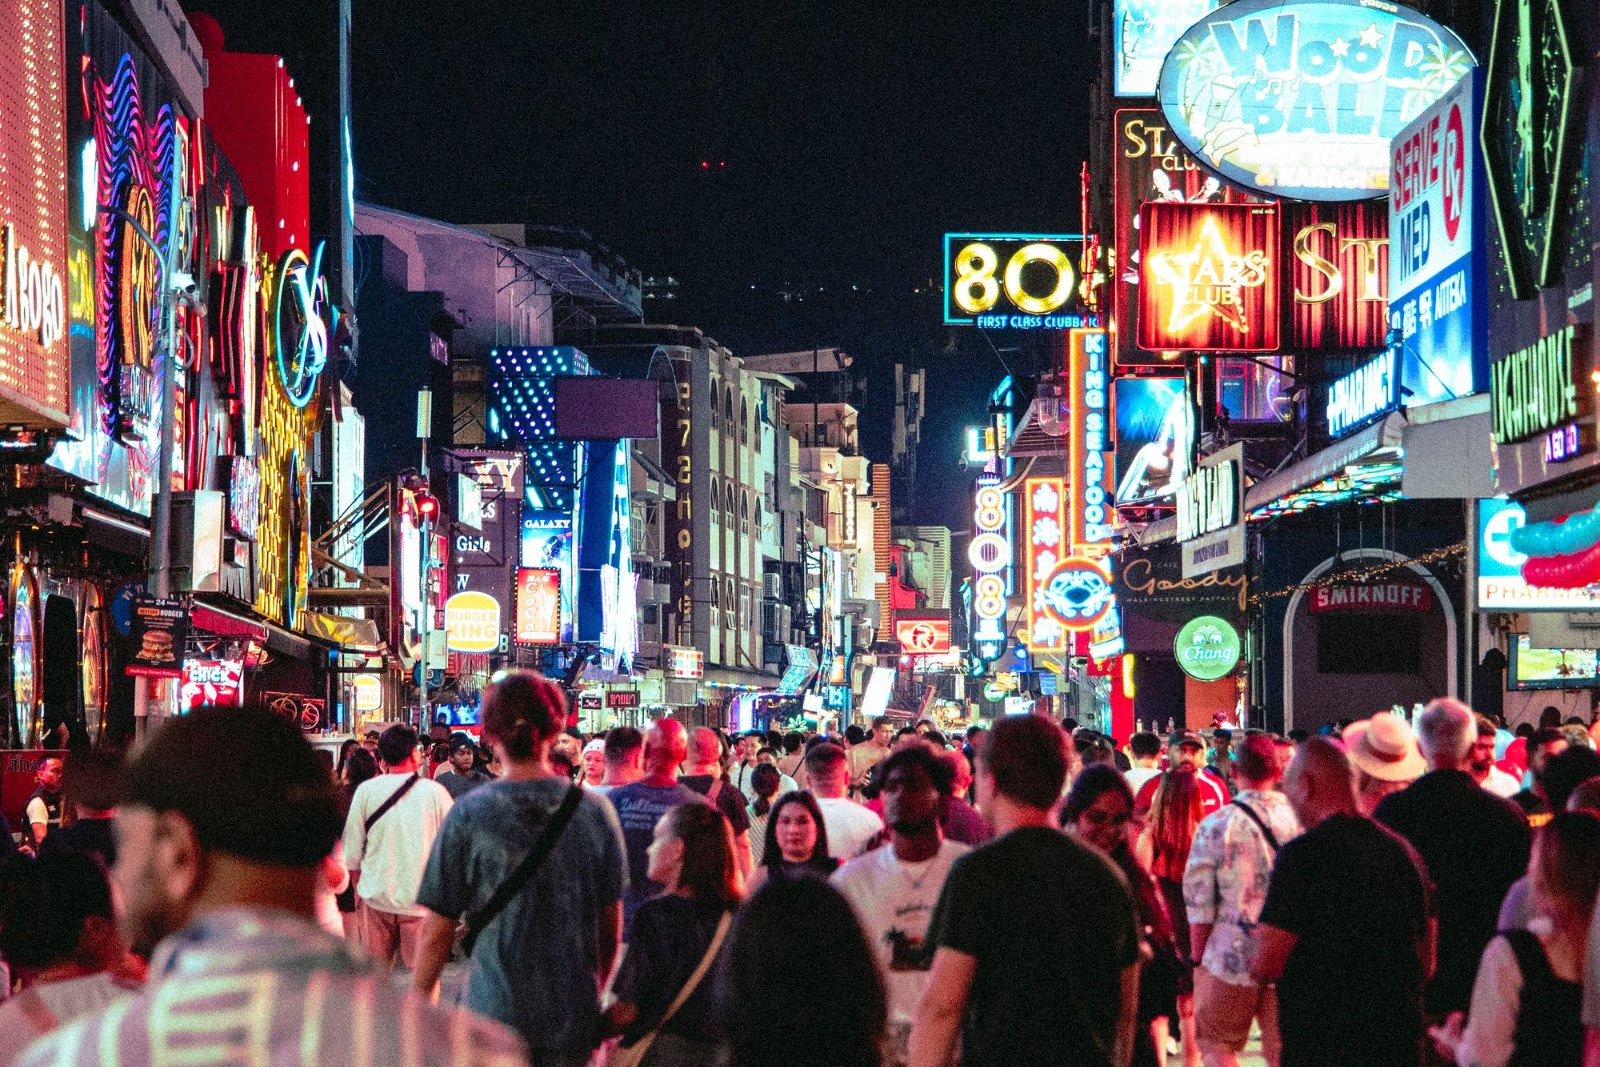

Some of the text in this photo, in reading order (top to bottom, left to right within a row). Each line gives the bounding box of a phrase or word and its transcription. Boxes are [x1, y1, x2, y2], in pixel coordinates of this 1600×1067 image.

[1209, 14, 1443, 83] WOOD
[1393, 114, 1440, 214] SERVE
[1400, 200, 1430, 283] MED
[1155, 250, 1266, 287] STARS
[1184, 285, 1236, 305] CLUB
[977, 316, 1007, 328] FIRST
[1010, 316, 1040, 328] CLASS
[1084, 333, 1106, 543] KING SEAFOOD
[525, 519, 571, 528] GALAXY
[456, 535, 490, 553] Girls
[1123, 558, 1248, 612] Goody
[160, 609, 184, 618] BURGER
[447, 611, 497, 621] BURGER
[447, 623, 497, 639] KING
[1184, 645, 1232, 661] Chang
